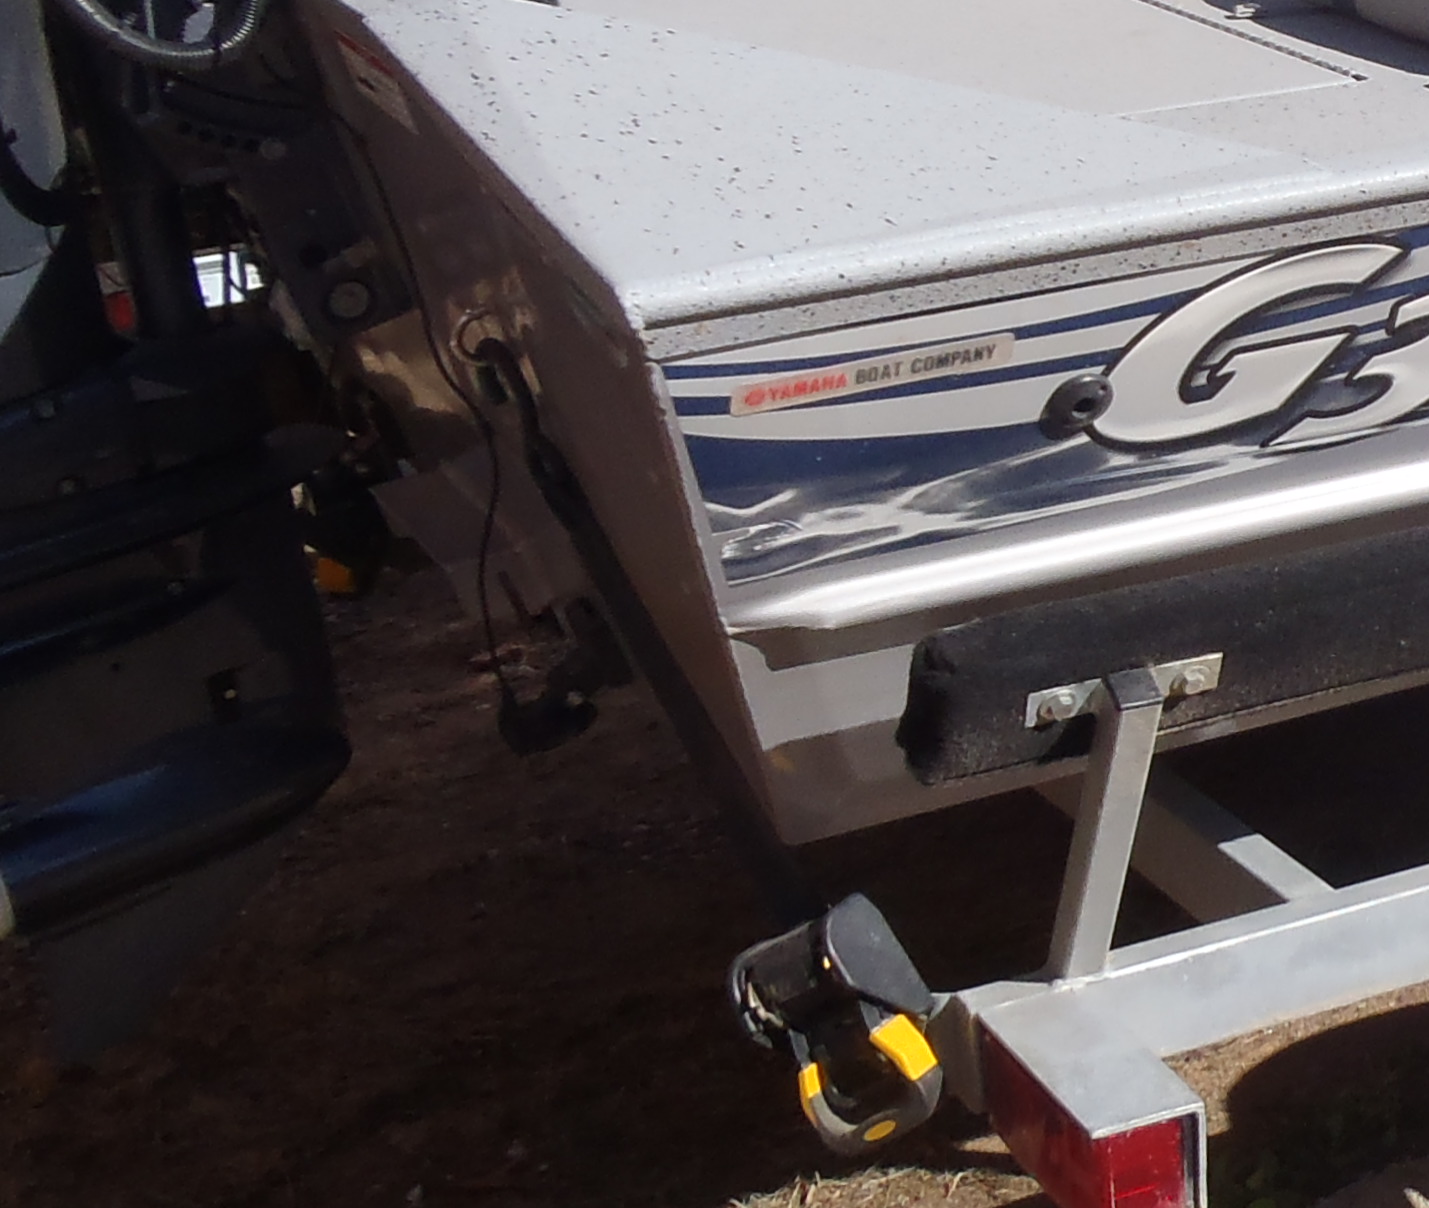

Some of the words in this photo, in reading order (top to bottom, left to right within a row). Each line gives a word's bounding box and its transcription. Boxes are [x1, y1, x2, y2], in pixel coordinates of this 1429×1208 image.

[768, 372, 848, 401] YAMAHA
[854, 361, 905, 385] BOAT
[911, 344, 997, 374] COMPANY
